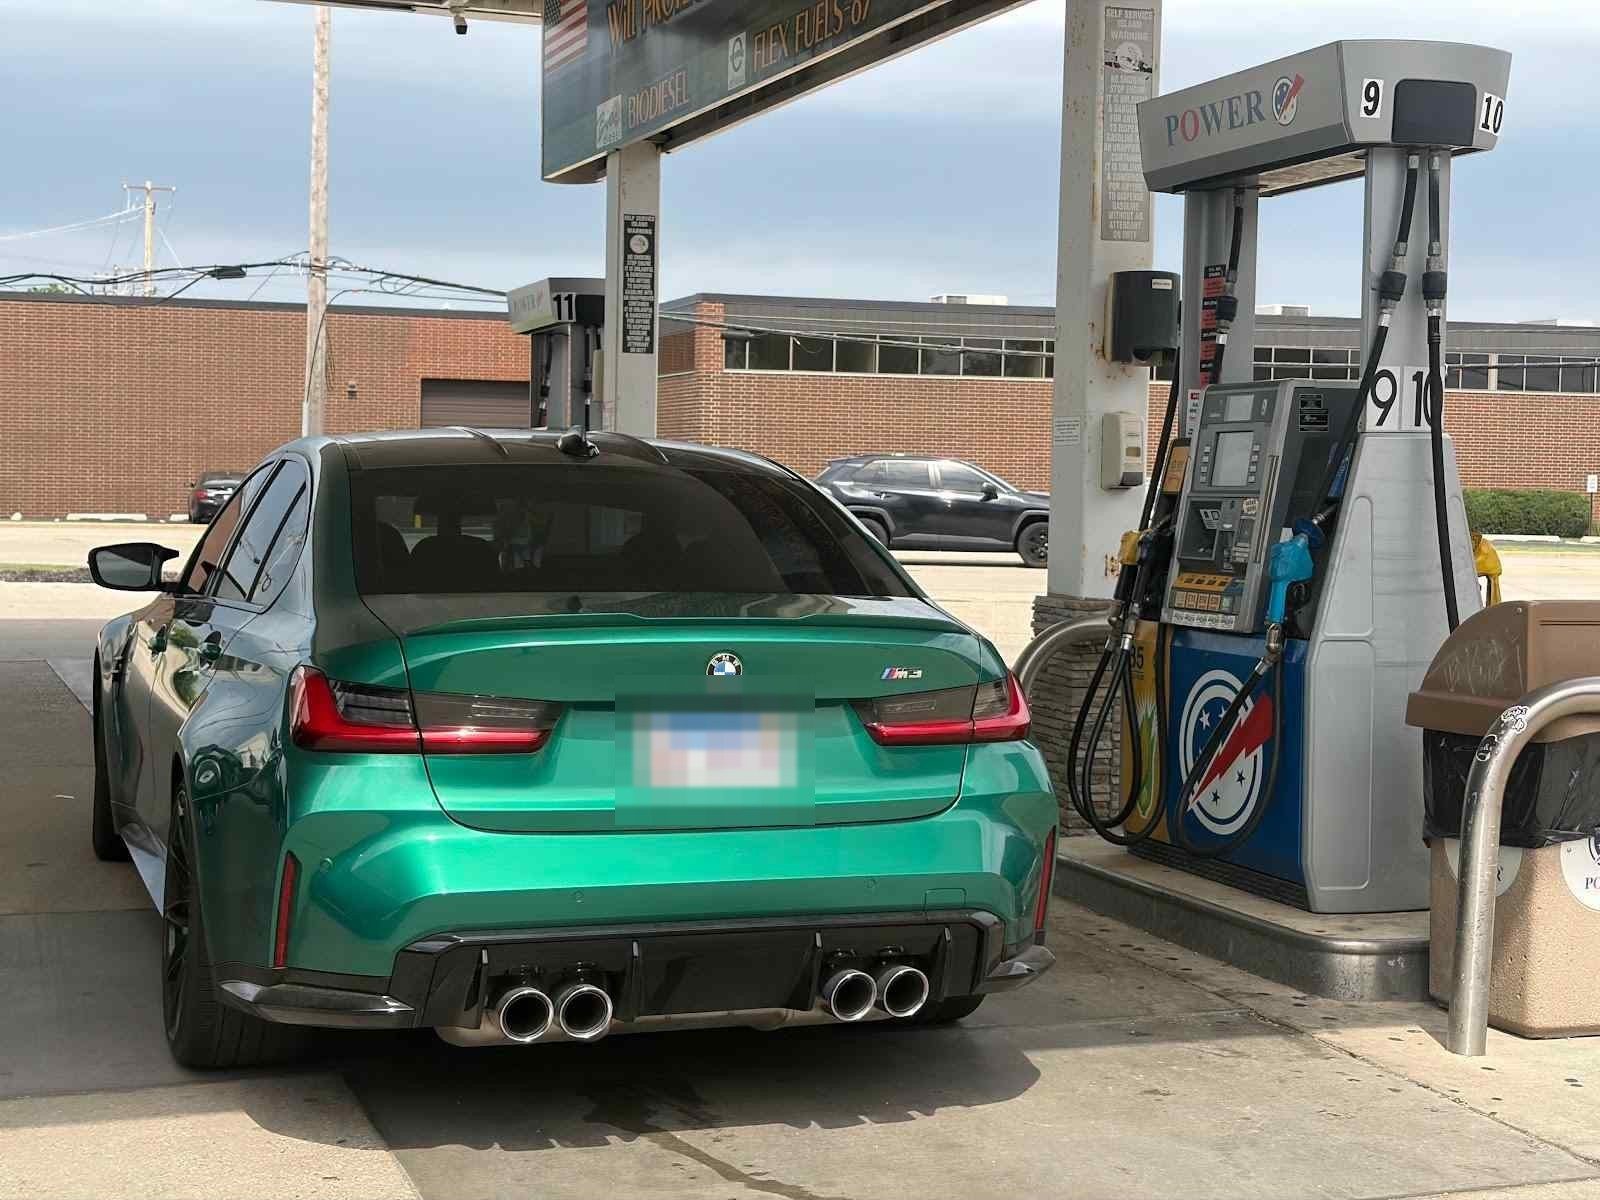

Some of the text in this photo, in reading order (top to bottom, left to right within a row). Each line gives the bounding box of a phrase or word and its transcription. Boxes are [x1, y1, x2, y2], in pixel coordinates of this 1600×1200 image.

[753, 19, 789, 73] FLEX
[628, 72, 688, 128] BIODIESEL
[1164, 90, 1266, 147] POWER
[1364, 81, 1380, 116] 9
[1481, 96, 1504, 134] 10
[553, 293, 573, 320] 11
[1371, 369, 1398, 426] 9
